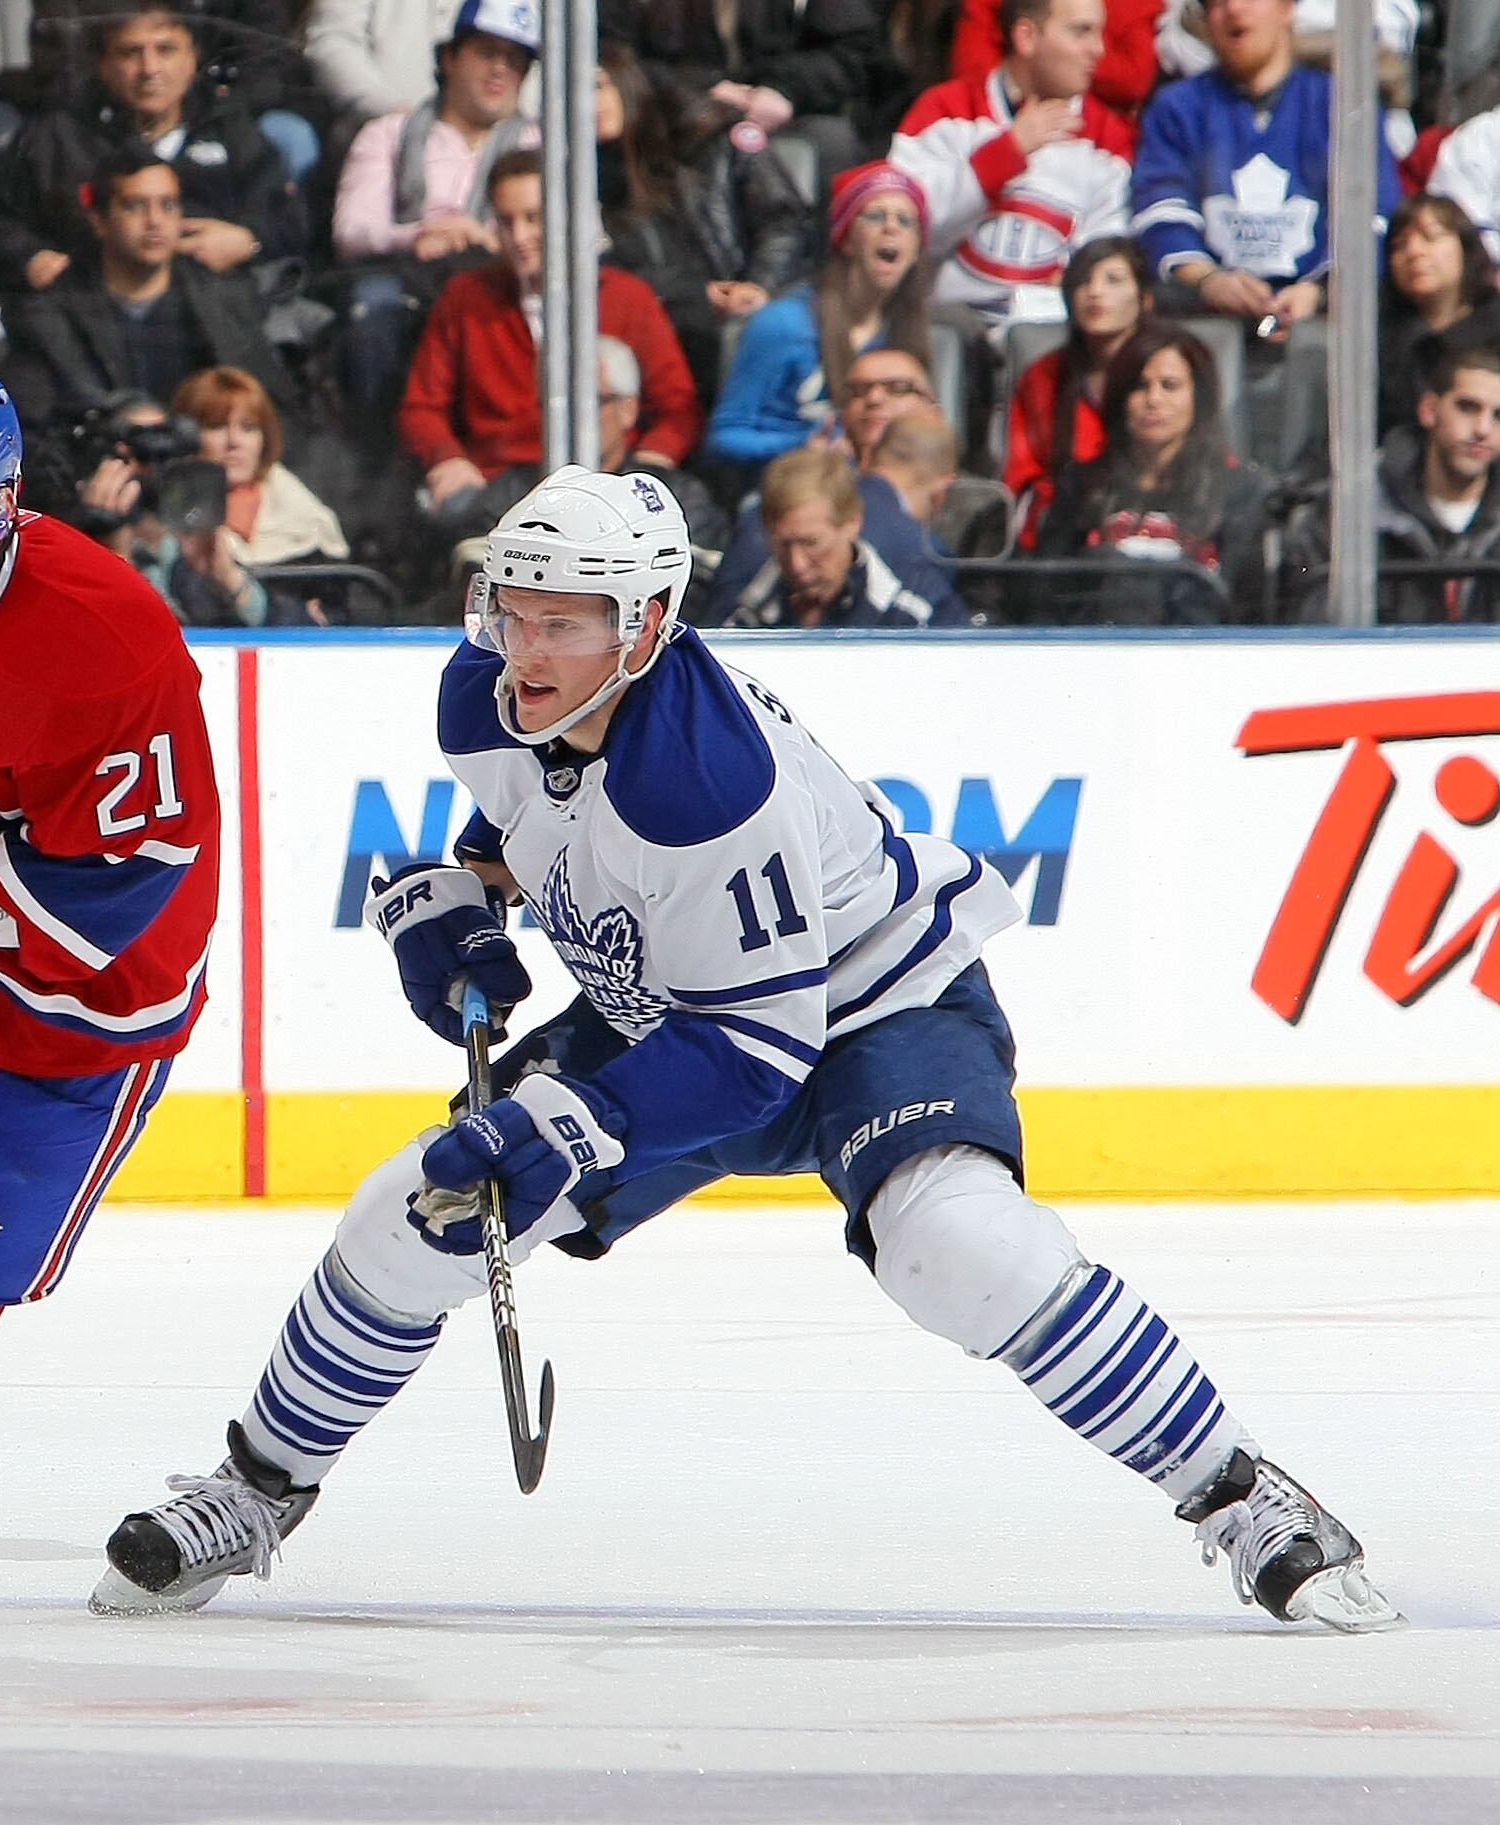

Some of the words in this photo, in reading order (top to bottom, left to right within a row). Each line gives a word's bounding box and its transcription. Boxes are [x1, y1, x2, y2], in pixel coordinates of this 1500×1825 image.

[94, 733, 183, 836] 21
[725, 851, 809, 954] 11
[1233, 690, 1500, 1026] Ti
